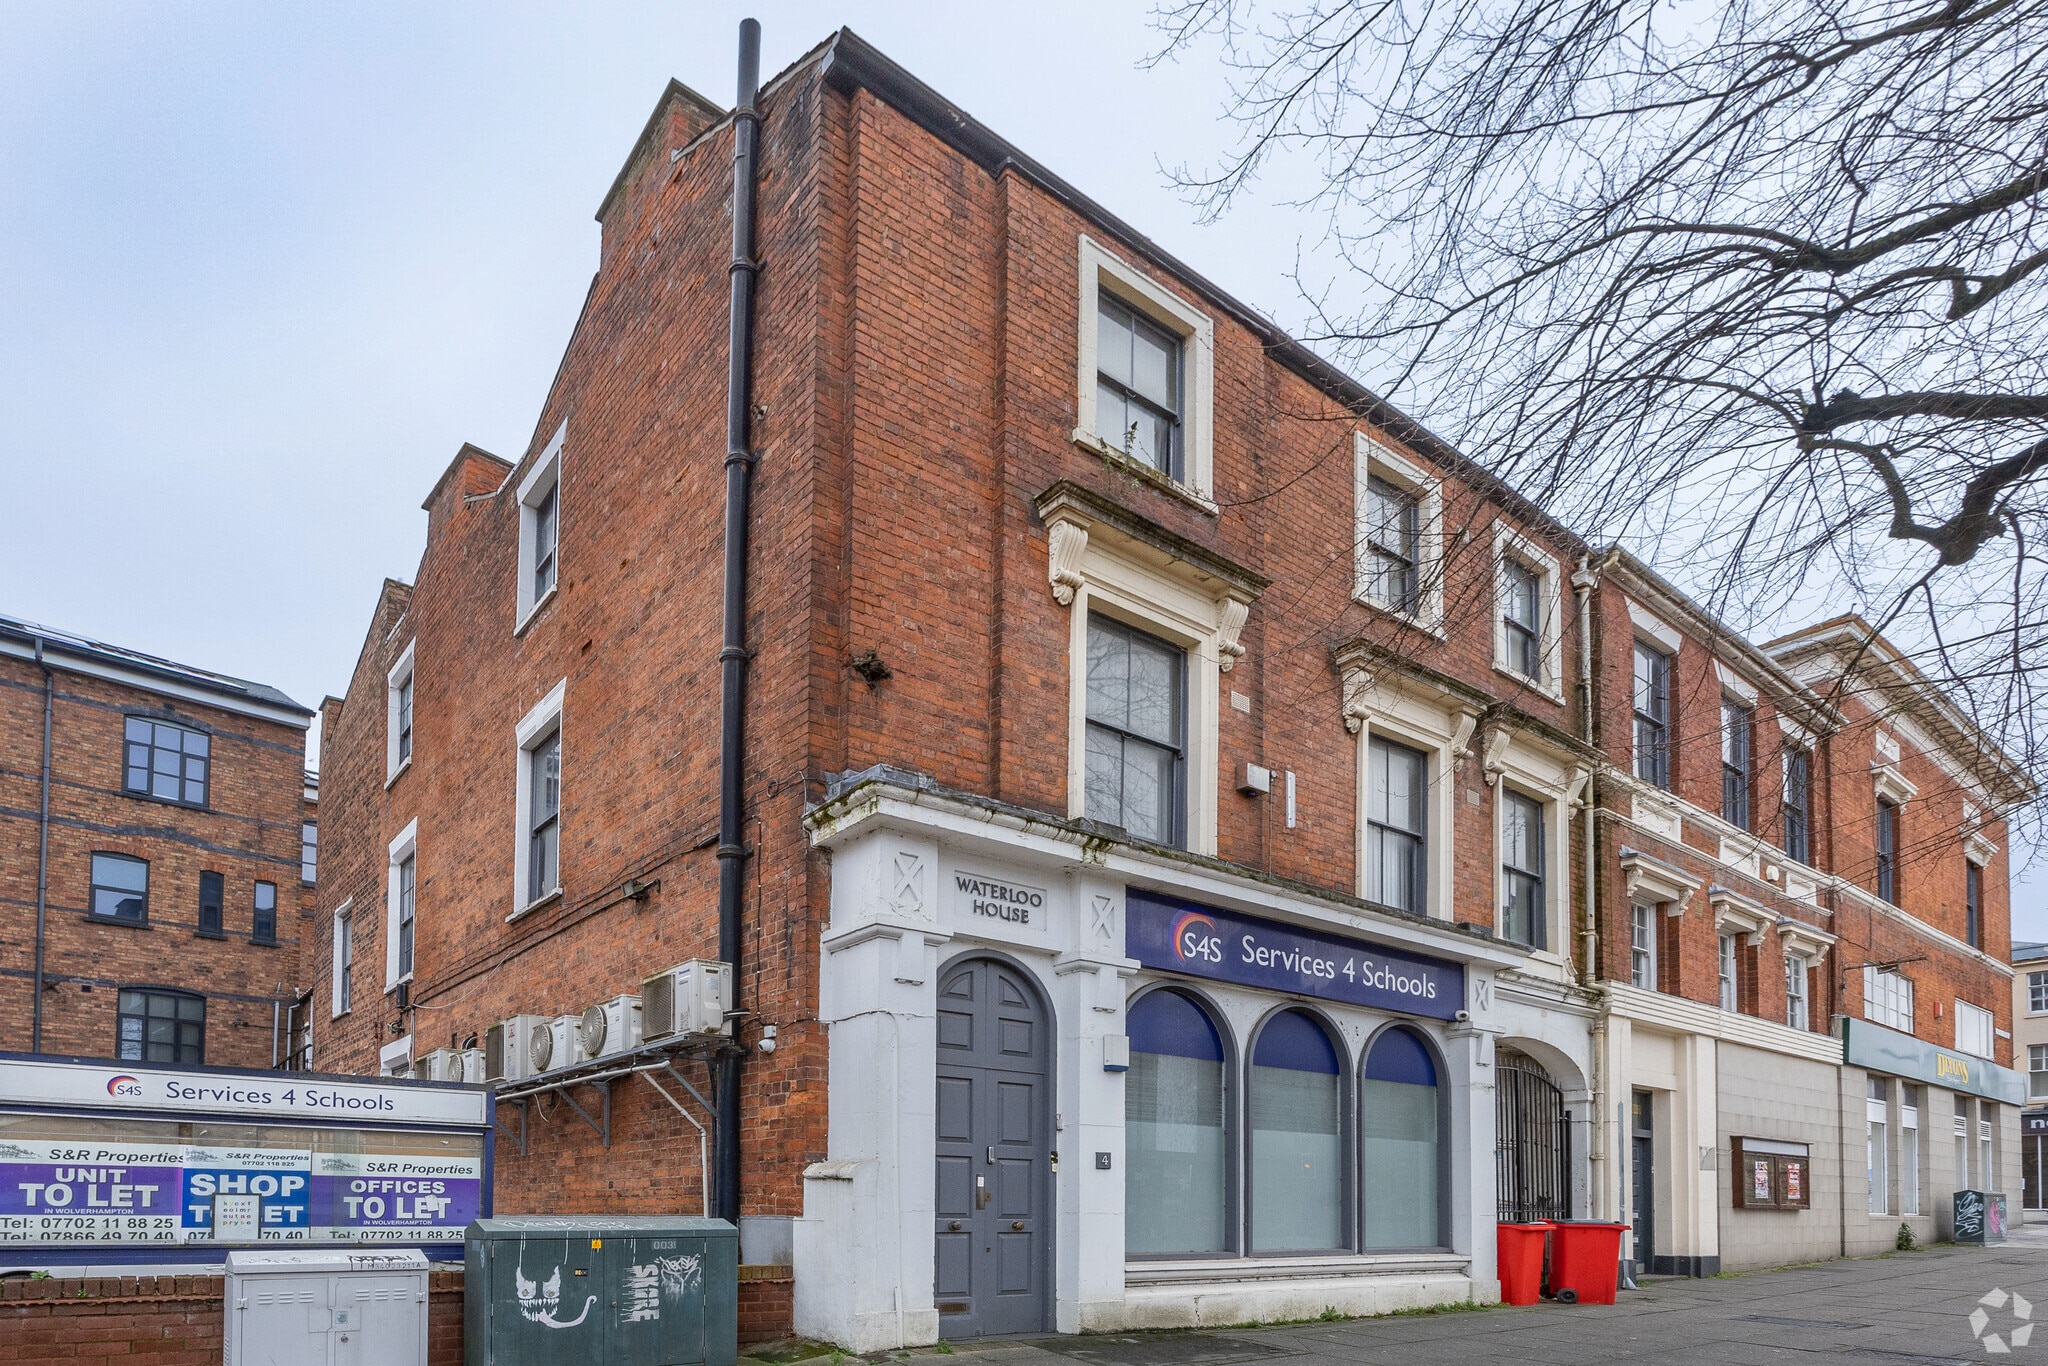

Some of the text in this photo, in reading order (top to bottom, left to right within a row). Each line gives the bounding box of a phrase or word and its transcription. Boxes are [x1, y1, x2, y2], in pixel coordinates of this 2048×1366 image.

[956, 876, 1042, 907] WATERLOO
[973, 899, 1029, 924] HOUSE
[1184, 932, 1436, 999] S4S Services 4 Schools
[117, 1081, 394, 1111] S4S Services 4 Schools
[49, 1149, 184, 1164] S&R Properties
[253, 1153, 309, 1161] Properties
[1101, 1155, 1109, 1165] 4
[55, 1168, 127, 1183] UNIT
[366, 1163, 473, 1175] S&R Properties
[190, 1174, 305, 1197] SHOP
[350, 1180, 446, 1194] OFFICES
[18, 1183, 160, 1208] TO LET
[261, 1206, 304, 1222] ET
[343, 1196, 452, 1219] TO LET
[1, 1217, 173, 1229] Tel: 07702 11 88 25
[0, 1231, 174, 1240] Tel: 07866 49 70 40
[263, 1231, 280, 1239] 70
[285, 1231, 303, 1239] 40
[329, 1230, 463, 1239] Tel: 07702 11 88 25
